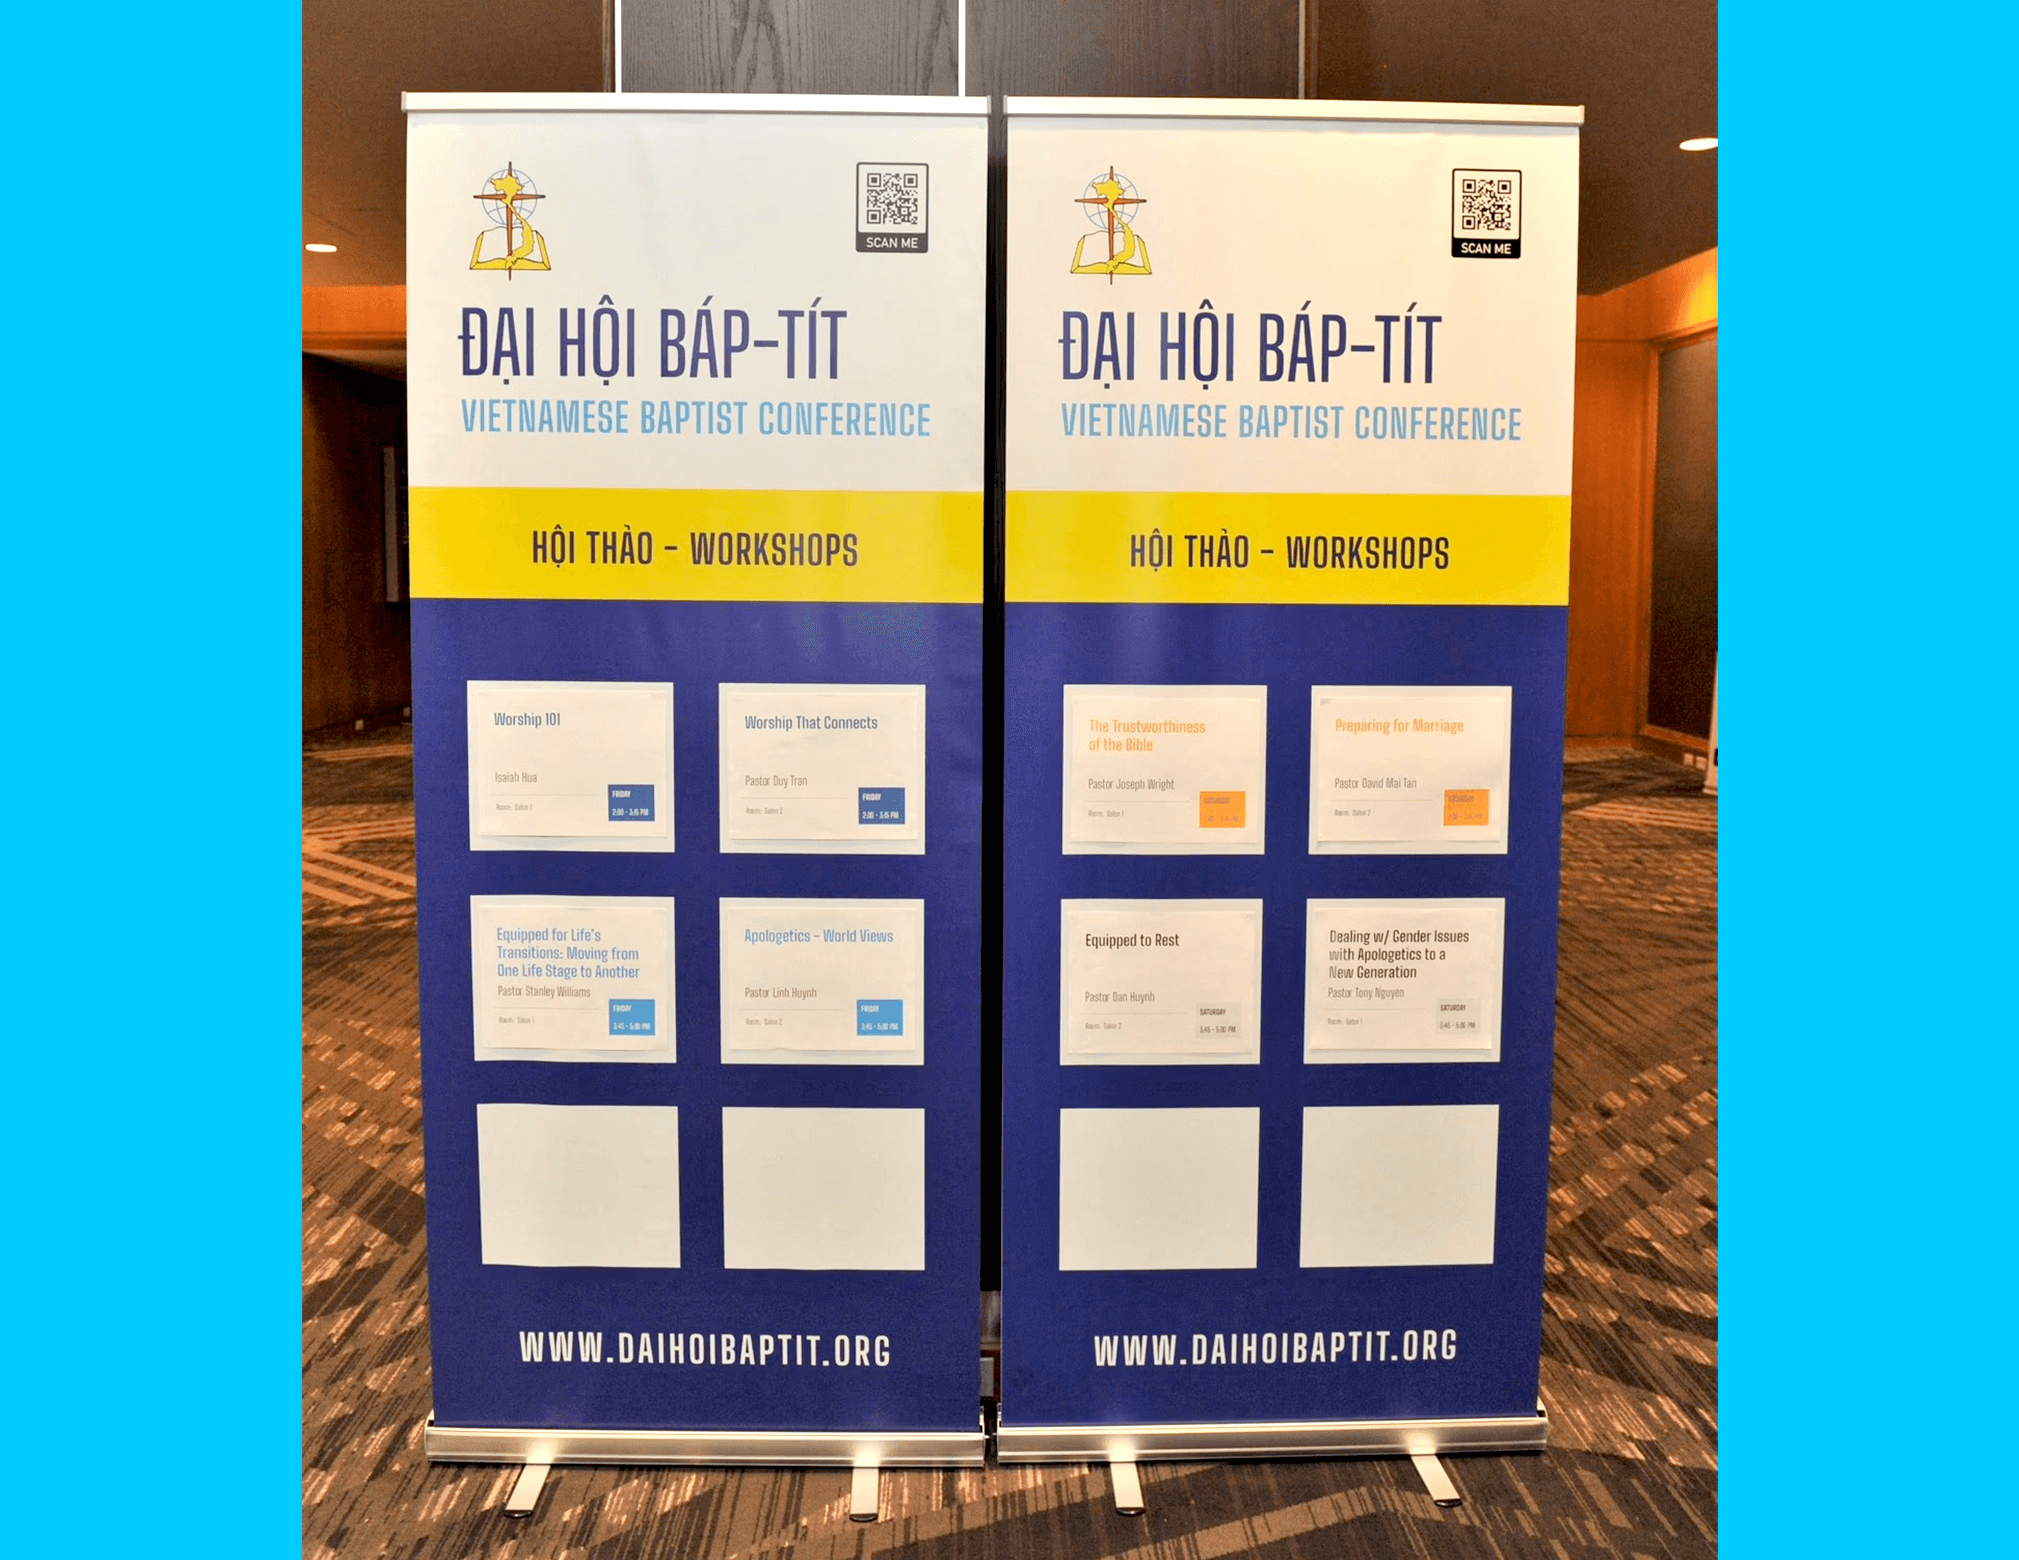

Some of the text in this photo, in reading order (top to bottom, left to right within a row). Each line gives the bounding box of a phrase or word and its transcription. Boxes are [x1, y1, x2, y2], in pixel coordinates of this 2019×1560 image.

[865, 236, 919, 250] SCAN ME
[1460, 239, 1512, 254] SCAN ME
[457, 294, 848, 387] ĐẠI HỘI BÁP-TÍT
[1058, 299, 1443, 391] ĐẠI HỘI BÁP-TÍT
[461, 399, 931, 437] VIETNAMESE BAPTIST CONFERENCE
[1061, 402, 1522, 441] VIETNAMESE BAPTIST CONFERENCE
[532, 524, 576, 569] HỘI
[586, 524, 654, 566] THẢO
[690, 532, 860, 568] WORKSHOPS
[1130, 528, 1174, 573] HỘI
[1184, 528, 1250, 570] THẢO
[1286, 536, 1450, 570] WORKSHOPS
[493, 712, 561, 729] Worship 101
[744, 716, 879, 732] Worship That Connects
[1089, 719, 1207, 734] The Trustworthiness
[1335, 718, 1465, 735] Preparing for Marriage
[1089, 738, 1154, 752] of the Bible
[494, 771, 538, 783] Isaiah Hua
[744, 775, 808, 789] Pastor Duy Tran
[1334, 777, 1417, 789] Pastor David Mai Tan
[1088, 778, 1175, 792] Pastor Joseph Wright
[611, 790, 631, 799] FRIDAY
[862, 793, 881, 801] FRIDAY
[497, 927, 549, 944] Equipped
[551, 928, 569, 942] for
[744, 928, 811, 945] Apologetics
[822, 928, 857, 943] World
[859, 928, 894, 943] Views
[1085, 932, 1180, 949] Equipped to Rest
[1329, 929, 1470, 945] Dealing w/ Gender Issues
[497, 945, 640, 963] Transitions: Moving from
[1329, 947, 1446, 964] with Apologetics to a
[497, 963, 641, 980] One Life Stage to Another
[1328, 965, 1418, 979] New Generation
[497, 985, 591, 999] Pastor Stanley Williams
[744, 987, 818, 1001] Pastor Linh Huynh
[1085, 991, 1156, 1004] Pastor Dan Huynh
[1327, 986, 1405, 1001] Pastor Tony Nguyen
[612, 1004, 632, 1013] FRIDAY
[860, 1004, 880, 1013] FRIDAY
[1199, 1008, 1227, 1016] SATURDAY
[1439, 1004, 1467, 1012] SATURDAY
[518, 1330, 890, 1367] WWW.DAIHOIBAPTIT.ORG
[1093, 1328, 1457, 1367] WWW.DAIHOIBAPTIT.ORG
